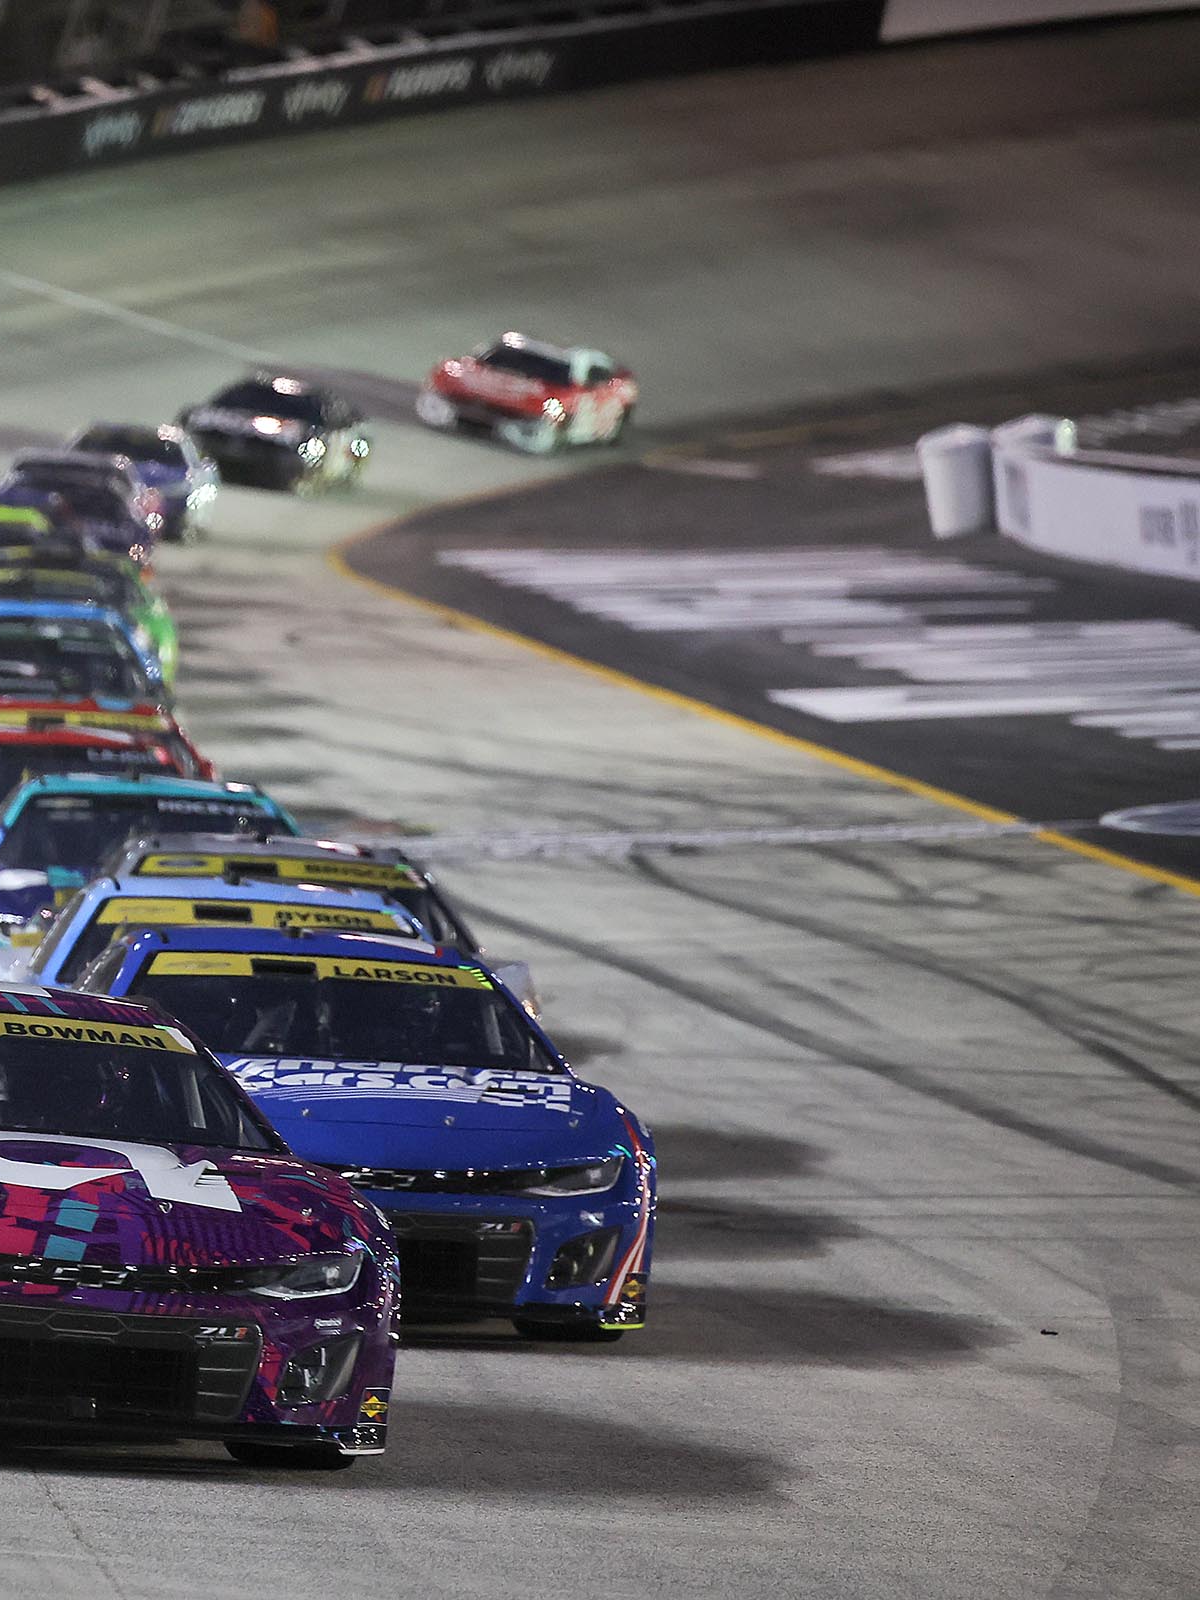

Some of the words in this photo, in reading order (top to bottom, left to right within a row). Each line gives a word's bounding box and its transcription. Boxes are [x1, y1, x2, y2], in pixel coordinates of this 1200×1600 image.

[276, 910, 374, 927] BYRON
[333, 965, 457, 985] LARSON
[4, 1022, 167, 1049] BOWMAN
[199, 1326, 248, 1340] ZL1
